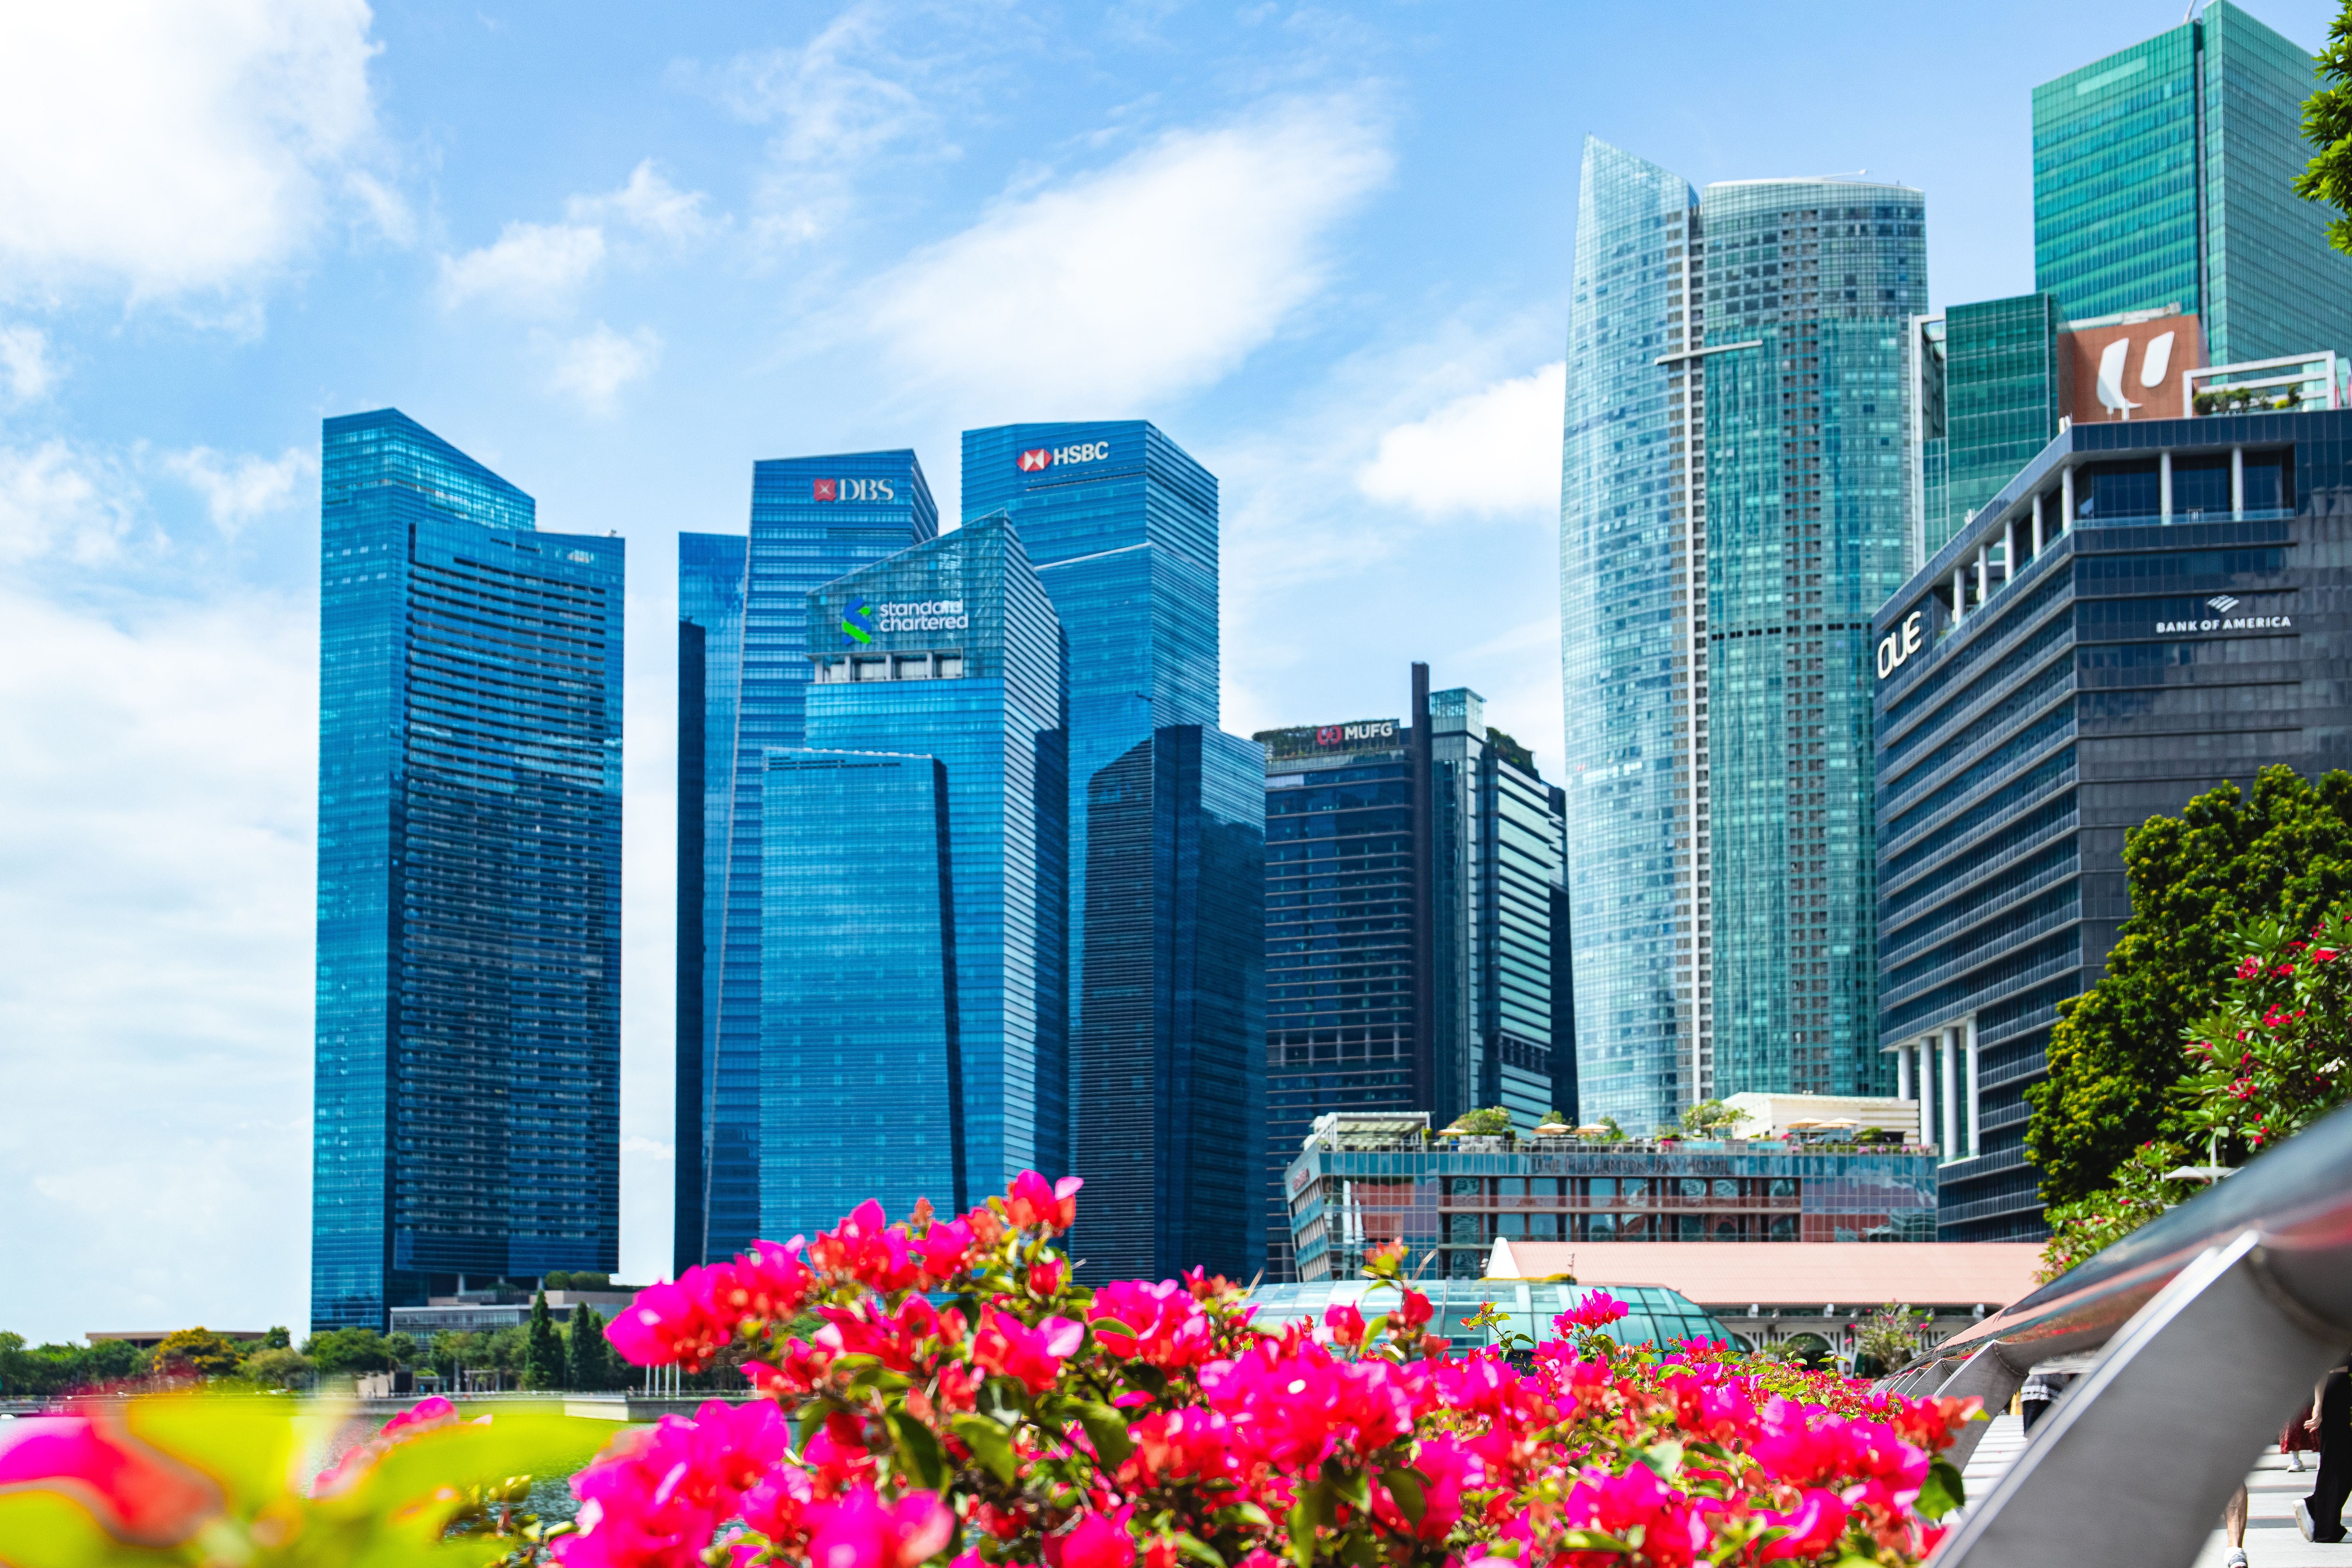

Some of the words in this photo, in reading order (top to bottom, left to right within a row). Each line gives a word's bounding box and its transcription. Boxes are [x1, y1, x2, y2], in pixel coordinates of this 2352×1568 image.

[1054, 441, 1109, 466] HSBC
[839, 478, 894, 501] DBS
[880, 599, 963, 617] standard
[879, 611, 969, 632] chartered
[2156, 620, 2197, 634] BANK
[2200, 620, 2220, 631] OF
[2222, 616, 2291, 630] AMERICA
[1877, 611, 1922, 679] OUE
[1344, 722, 1393, 741] MUFG
